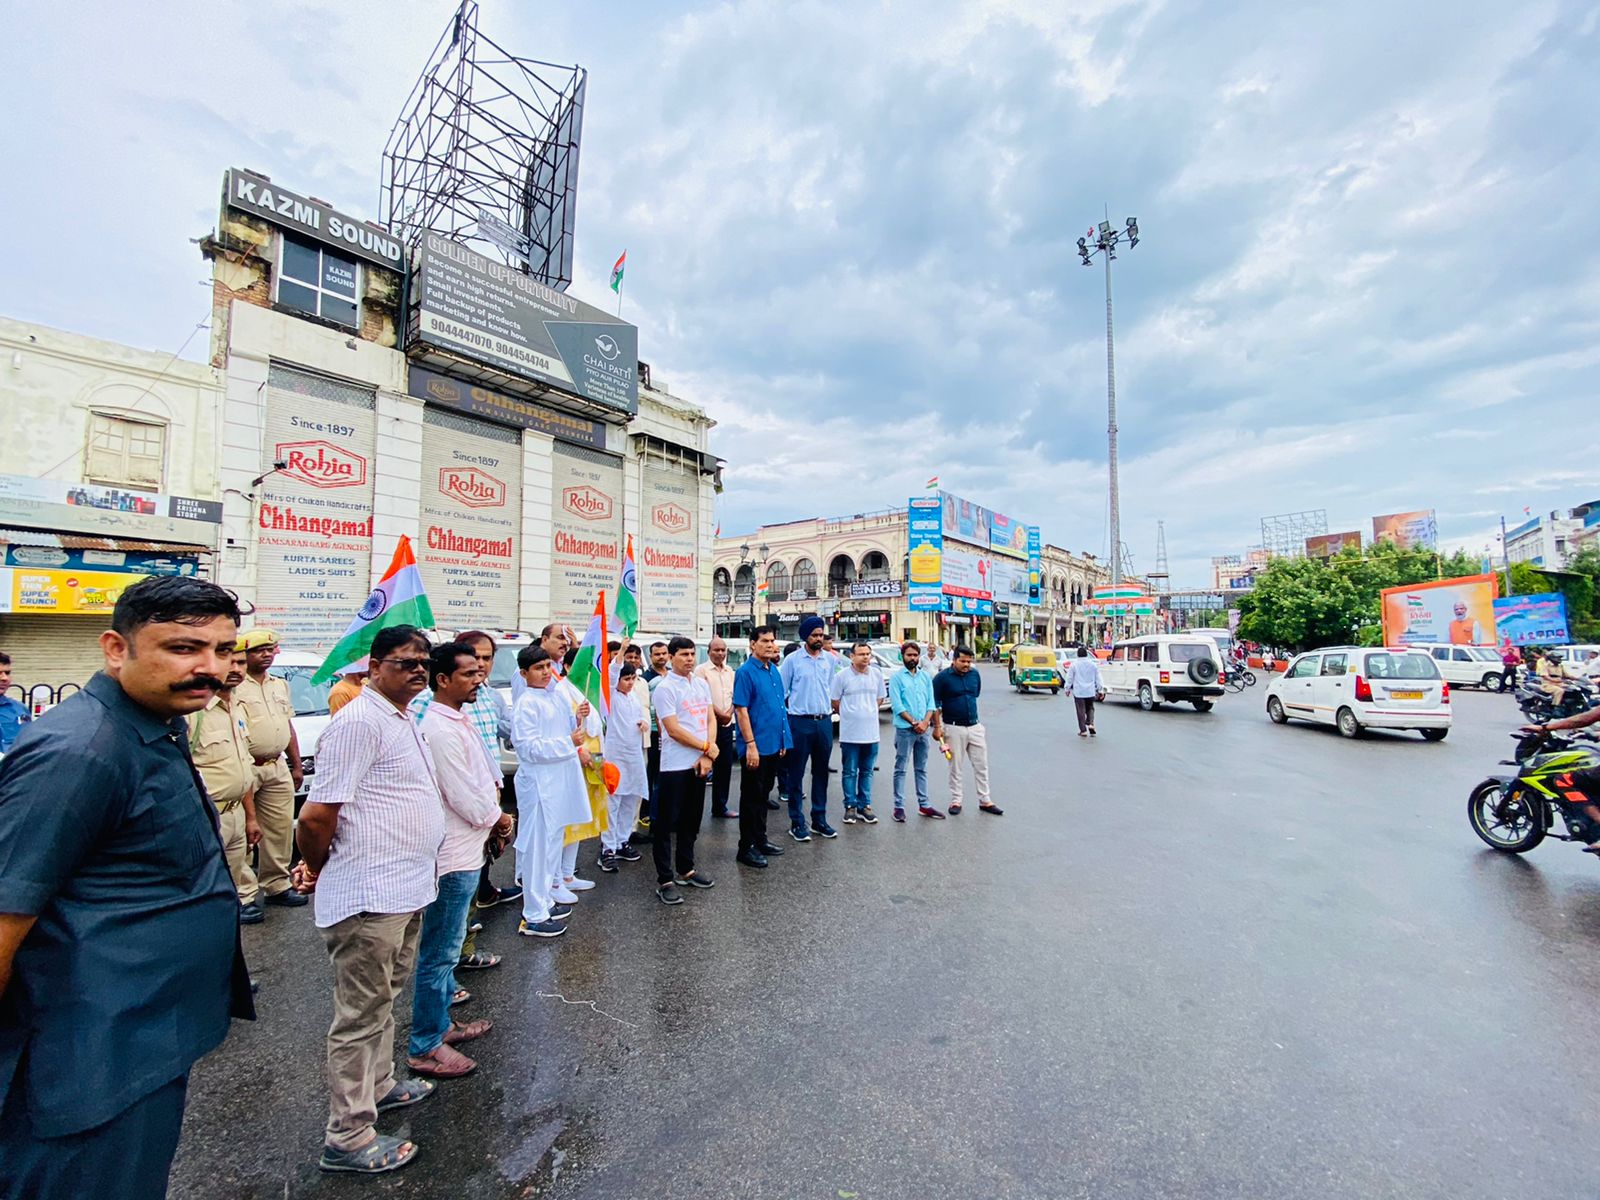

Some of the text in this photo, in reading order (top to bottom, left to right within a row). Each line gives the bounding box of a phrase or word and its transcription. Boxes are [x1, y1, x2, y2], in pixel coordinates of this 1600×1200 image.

[238, 178, 400, 261] KAZMI SOUND
[326, 274, 354, 288] SOUND
[329, 266, 352, 279] KAZMI
[428, 234, 578, 314] GOLDEN OPPORTUNITY
[427, 267, 516, 308] and earn high returns.
[427, 276, 504, 314] Small investments.
[428, 255, 462, 276] Become
[472, 276, 512, 297] successful
[514, 293, 560, 318] entrepreneur
[426, 286, 521, 330] Full backup of products
[426, 300, 528, 342] marketing and know how.
[496, 342, 549, 370] 9044544744
[584, 354, 631, 380] CHAI PATTI
[470, 387, 592, 433] Chhangamal
[176, 505, 206, 514] KRISHNA
[177, 499, 198, 507] SHREE
[260, 504, 374, 539] Chhangamal
[332, 542, 370, 552] AGENCIES
[427, 526, 512, 558] Chhangamal
[554, 530, 618, 560] Chhangamal
[284, 555, 356, 565] KURTA SAREES
[288, 568, 356, 576] LADIES SUITS
[442, 568, 501, 578] KURTA SAREES
[478, 580, 502, 588] SUITS
[864, 584, 900, 594] NIOS
[779, 614, 800, 622] Bata
